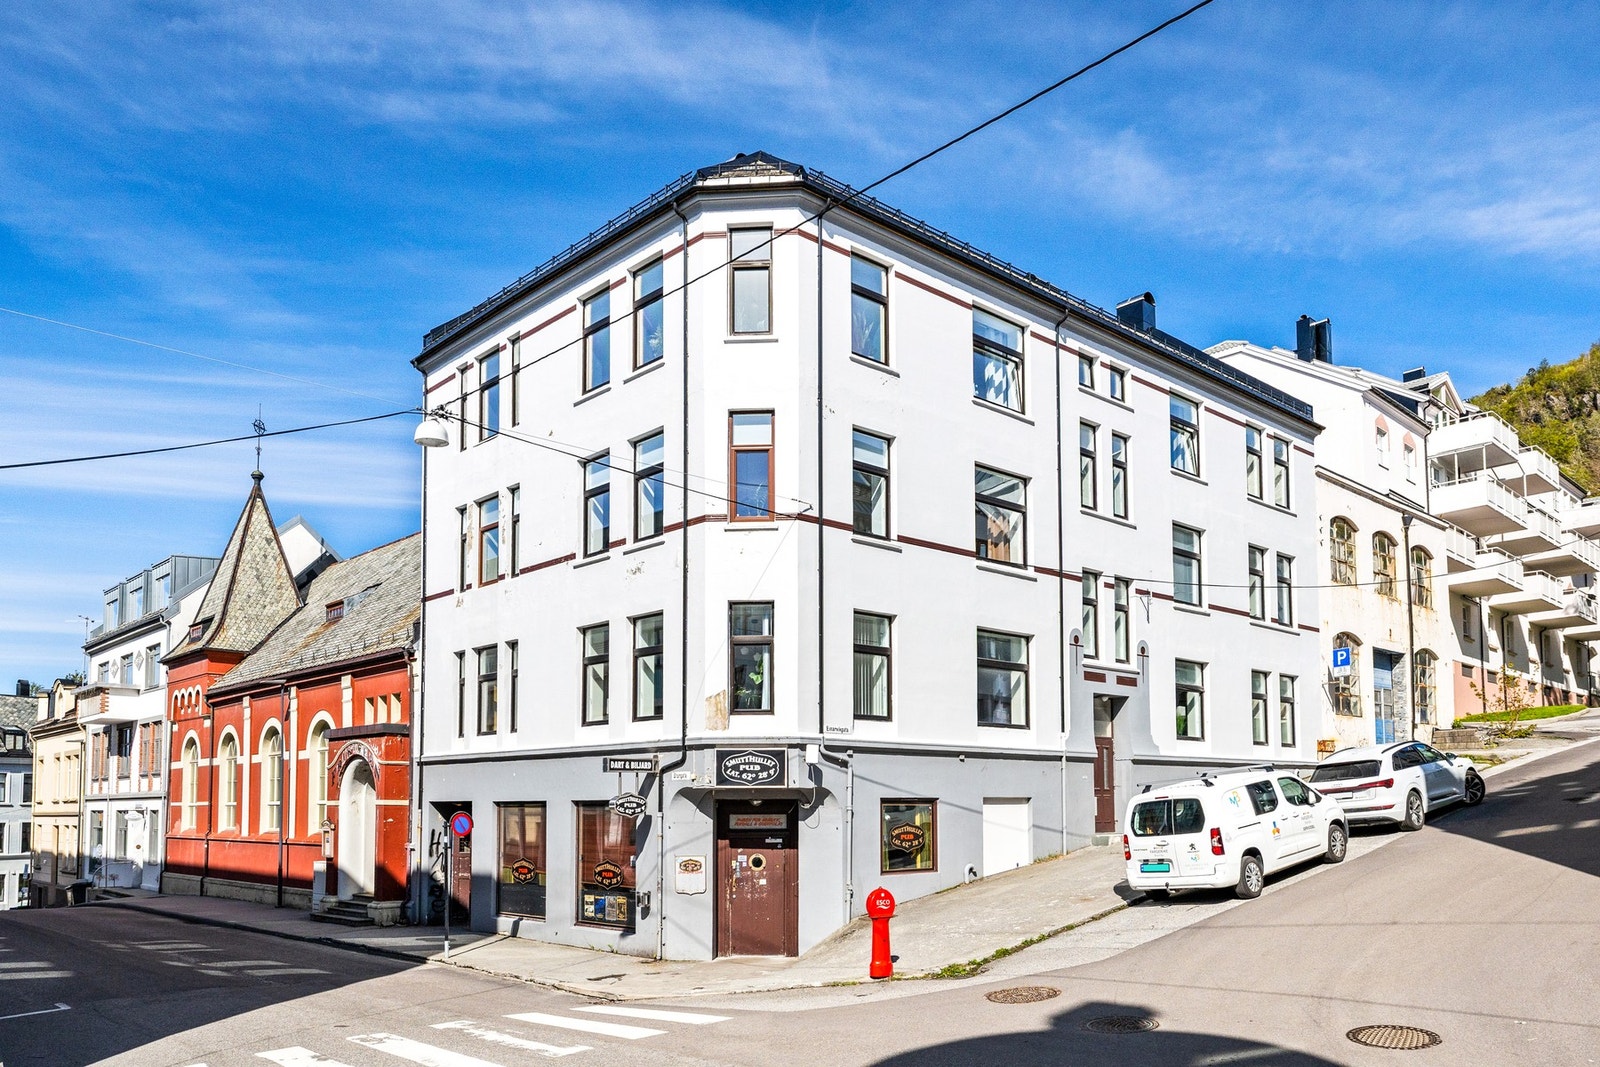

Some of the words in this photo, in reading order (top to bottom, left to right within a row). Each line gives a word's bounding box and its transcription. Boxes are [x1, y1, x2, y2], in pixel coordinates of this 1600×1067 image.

[1337, 651, 1347, 665] P
[610, 761, 625, 769] DART
[625, 761, 630, 769] &
[630, 761, 652, 769] BILJARD
[725, 755, 776, 767] SMUTTHULLET
